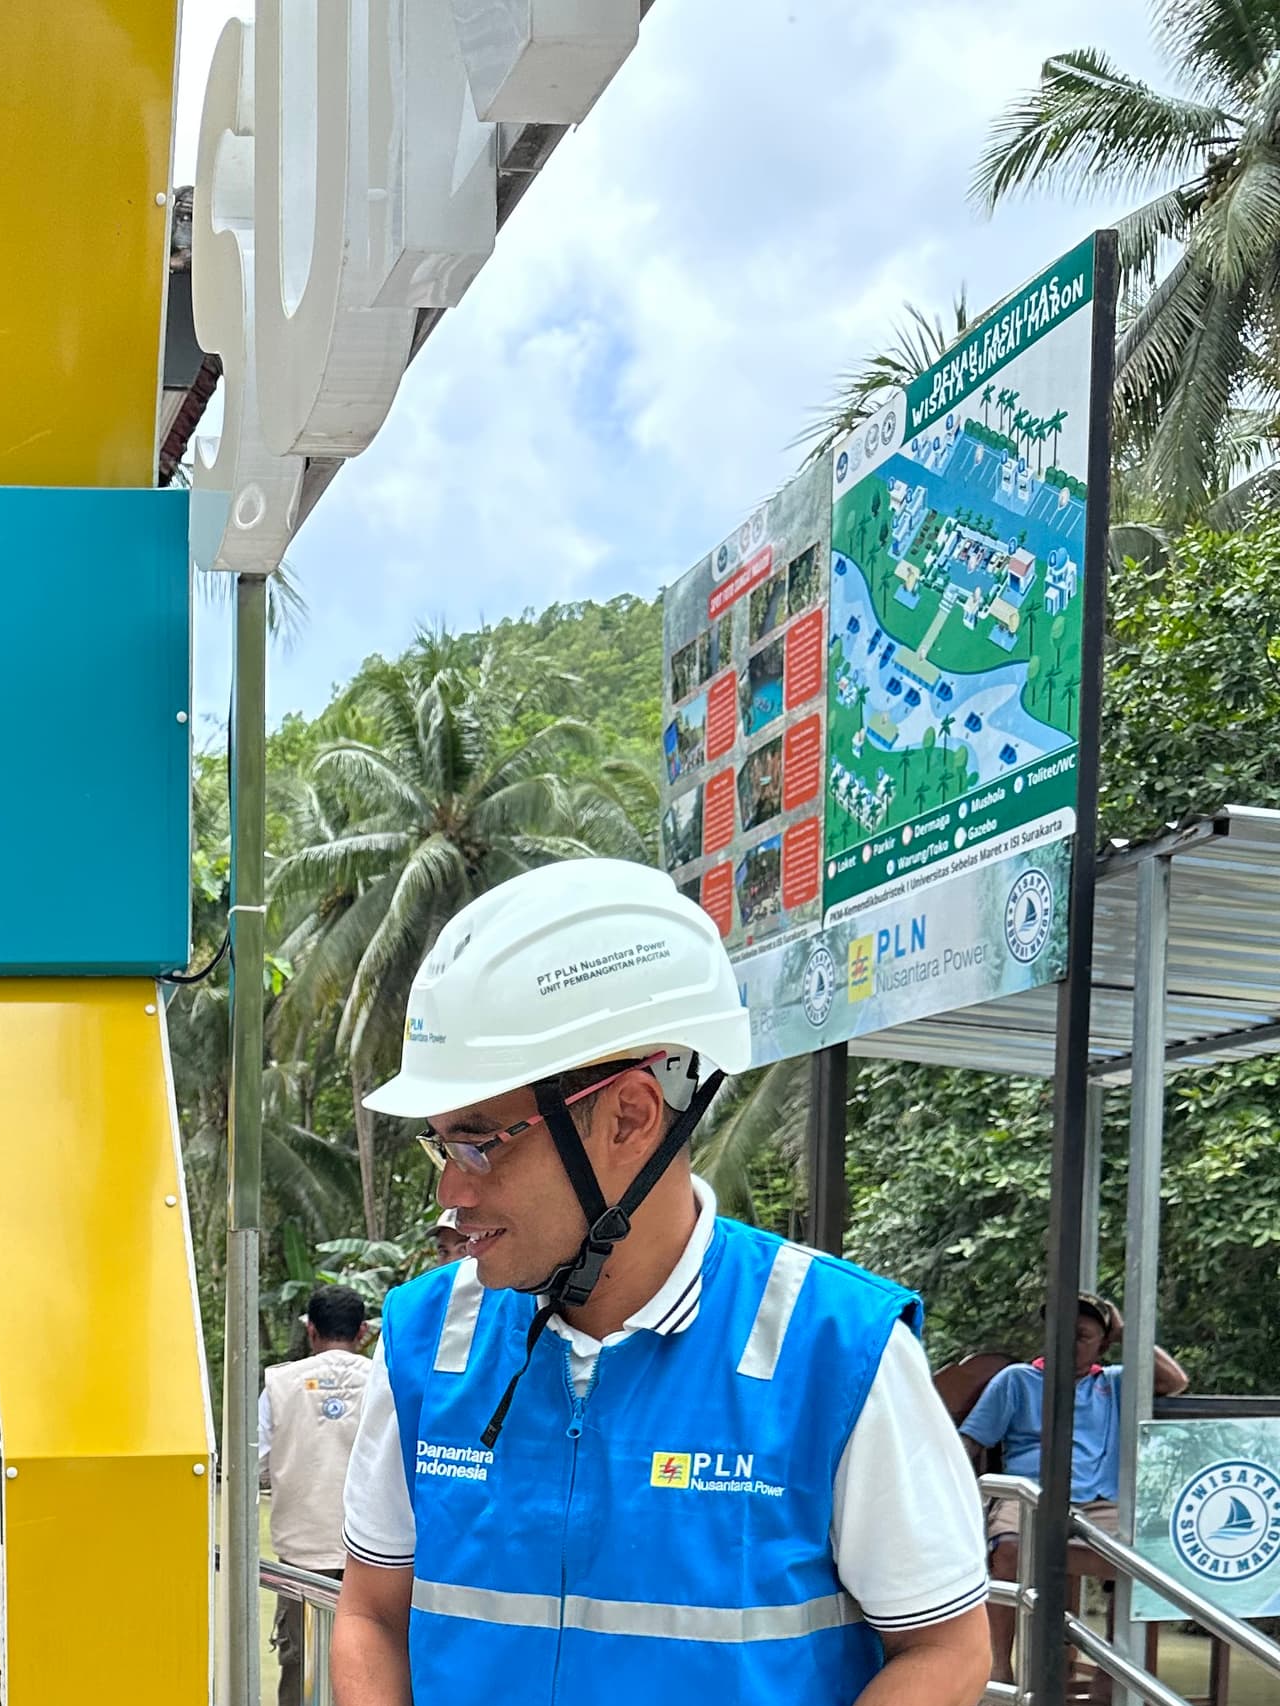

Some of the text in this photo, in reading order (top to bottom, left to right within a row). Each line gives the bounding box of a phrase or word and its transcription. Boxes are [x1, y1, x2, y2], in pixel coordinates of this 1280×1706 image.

[912, 274, 1084, 427] WISATA SUNGAI MARON
[934, 276, 1059, 394] DENAH FASILITAS
[837, 856, 857, 873] Loket
[873, 837, 896, 856] Parkir
[914, 814, 951, 838] Dermaga
[971, 787, 1006, 813] Mushola
[897, 818, 998, 870] Warung/Toko Gazebo
[910, 865, 951, 890] Universitas
[951, 855, 978, 874] Sebelas
[979, 843, 1002, 861] Maret
[1010, 834, 1020, 849] ISI
[1021, 820, 1063, 845] Surakarta
[1011, 876, 1047, 904] WISATA
[537, 940, 666, 986] PT PLN Nusantara Power
[877, 914, 927, 964] PLN
[540, 949, 671, 996] UNIT PEMBANGKITAN PACITAN
[875, 942, 988, 994] Nusantara Power
[415, 1457, 488, 1481] Indonesia
[416, 1440, 494, 1464] Danantara
[693, 1453, 754, 1478] PLN
[691, 1478, 786, 1497] Nusantara Power
[1191, 1470, 1277, 1501] WISATA
[1180, 1517, 1280, 1574] SUNGAI MARON
